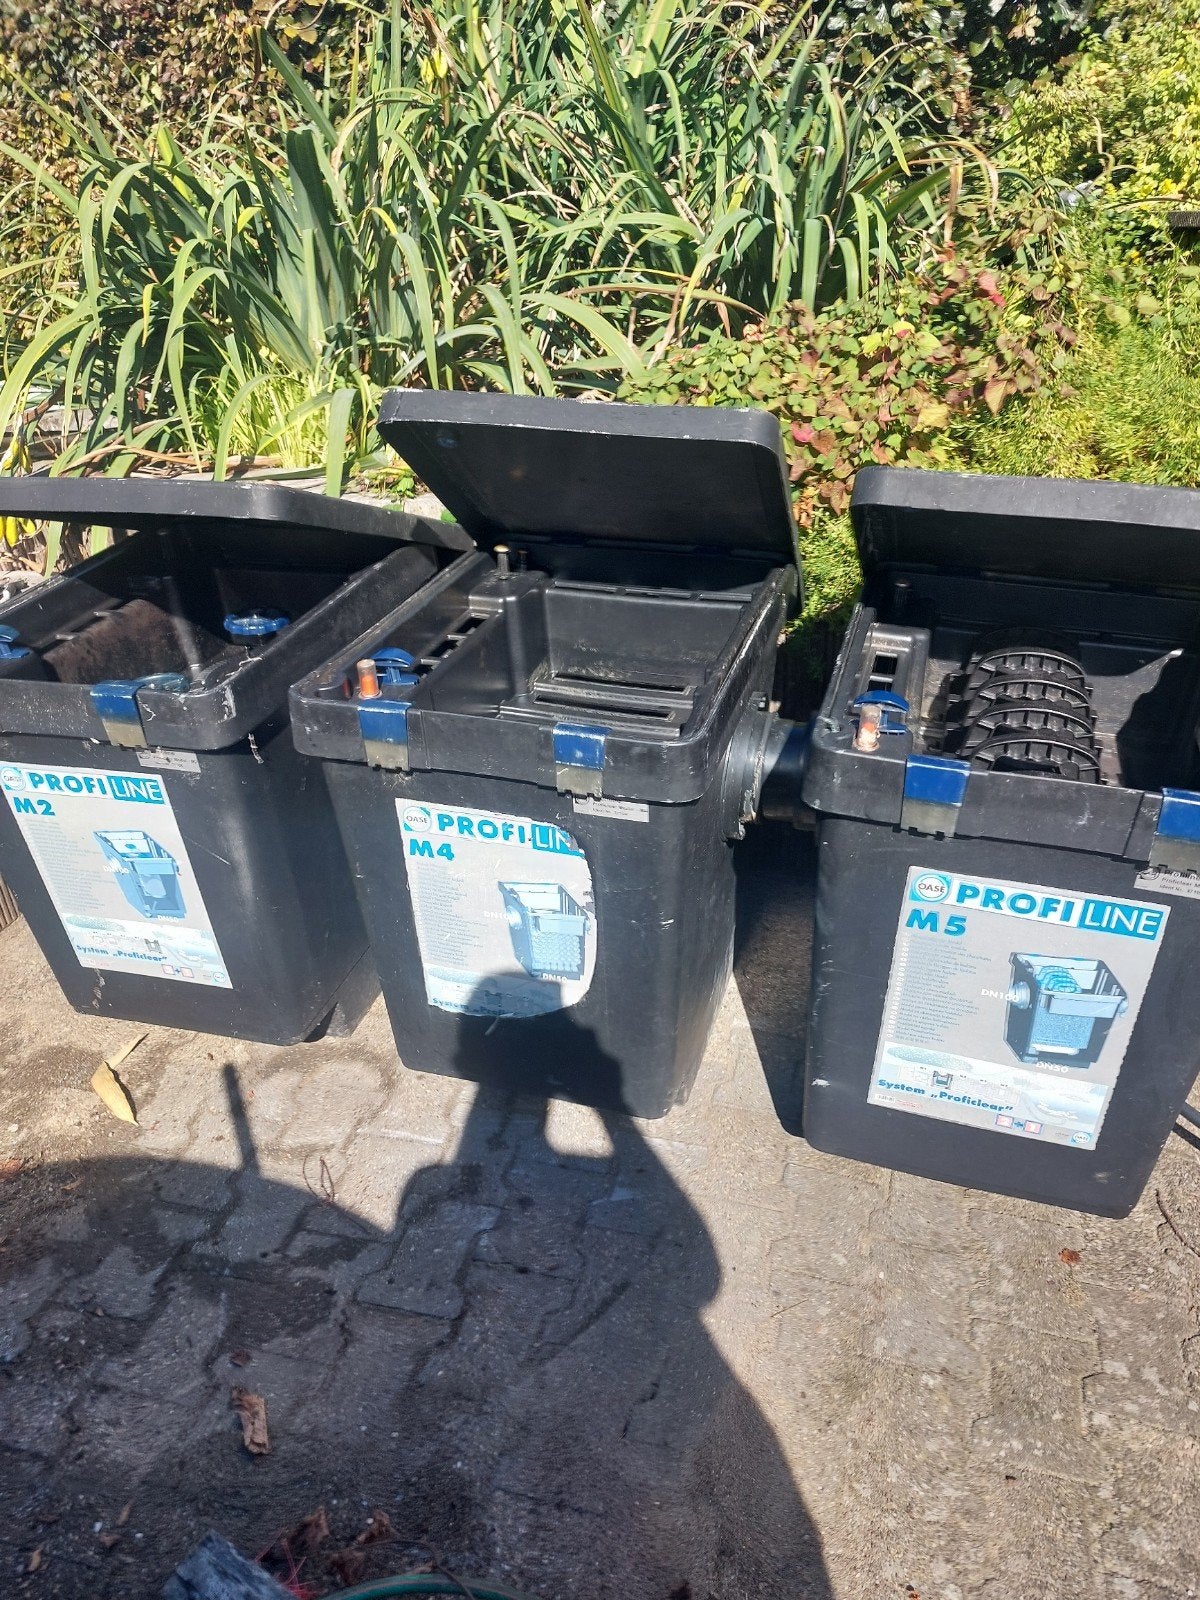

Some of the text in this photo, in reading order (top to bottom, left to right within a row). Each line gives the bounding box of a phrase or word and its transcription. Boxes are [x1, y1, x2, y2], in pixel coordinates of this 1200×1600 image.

[13, 797, 56, 816] M2
[406, 814, 428, 825] OASE
[409, 838, 455, 862] M4
[917, 880, 945, 895] OASE
[905, 908, 967, 937] M5
[1035, 1061, 1069, 1073] DN50
[877, 1078, 926, 1096] System
